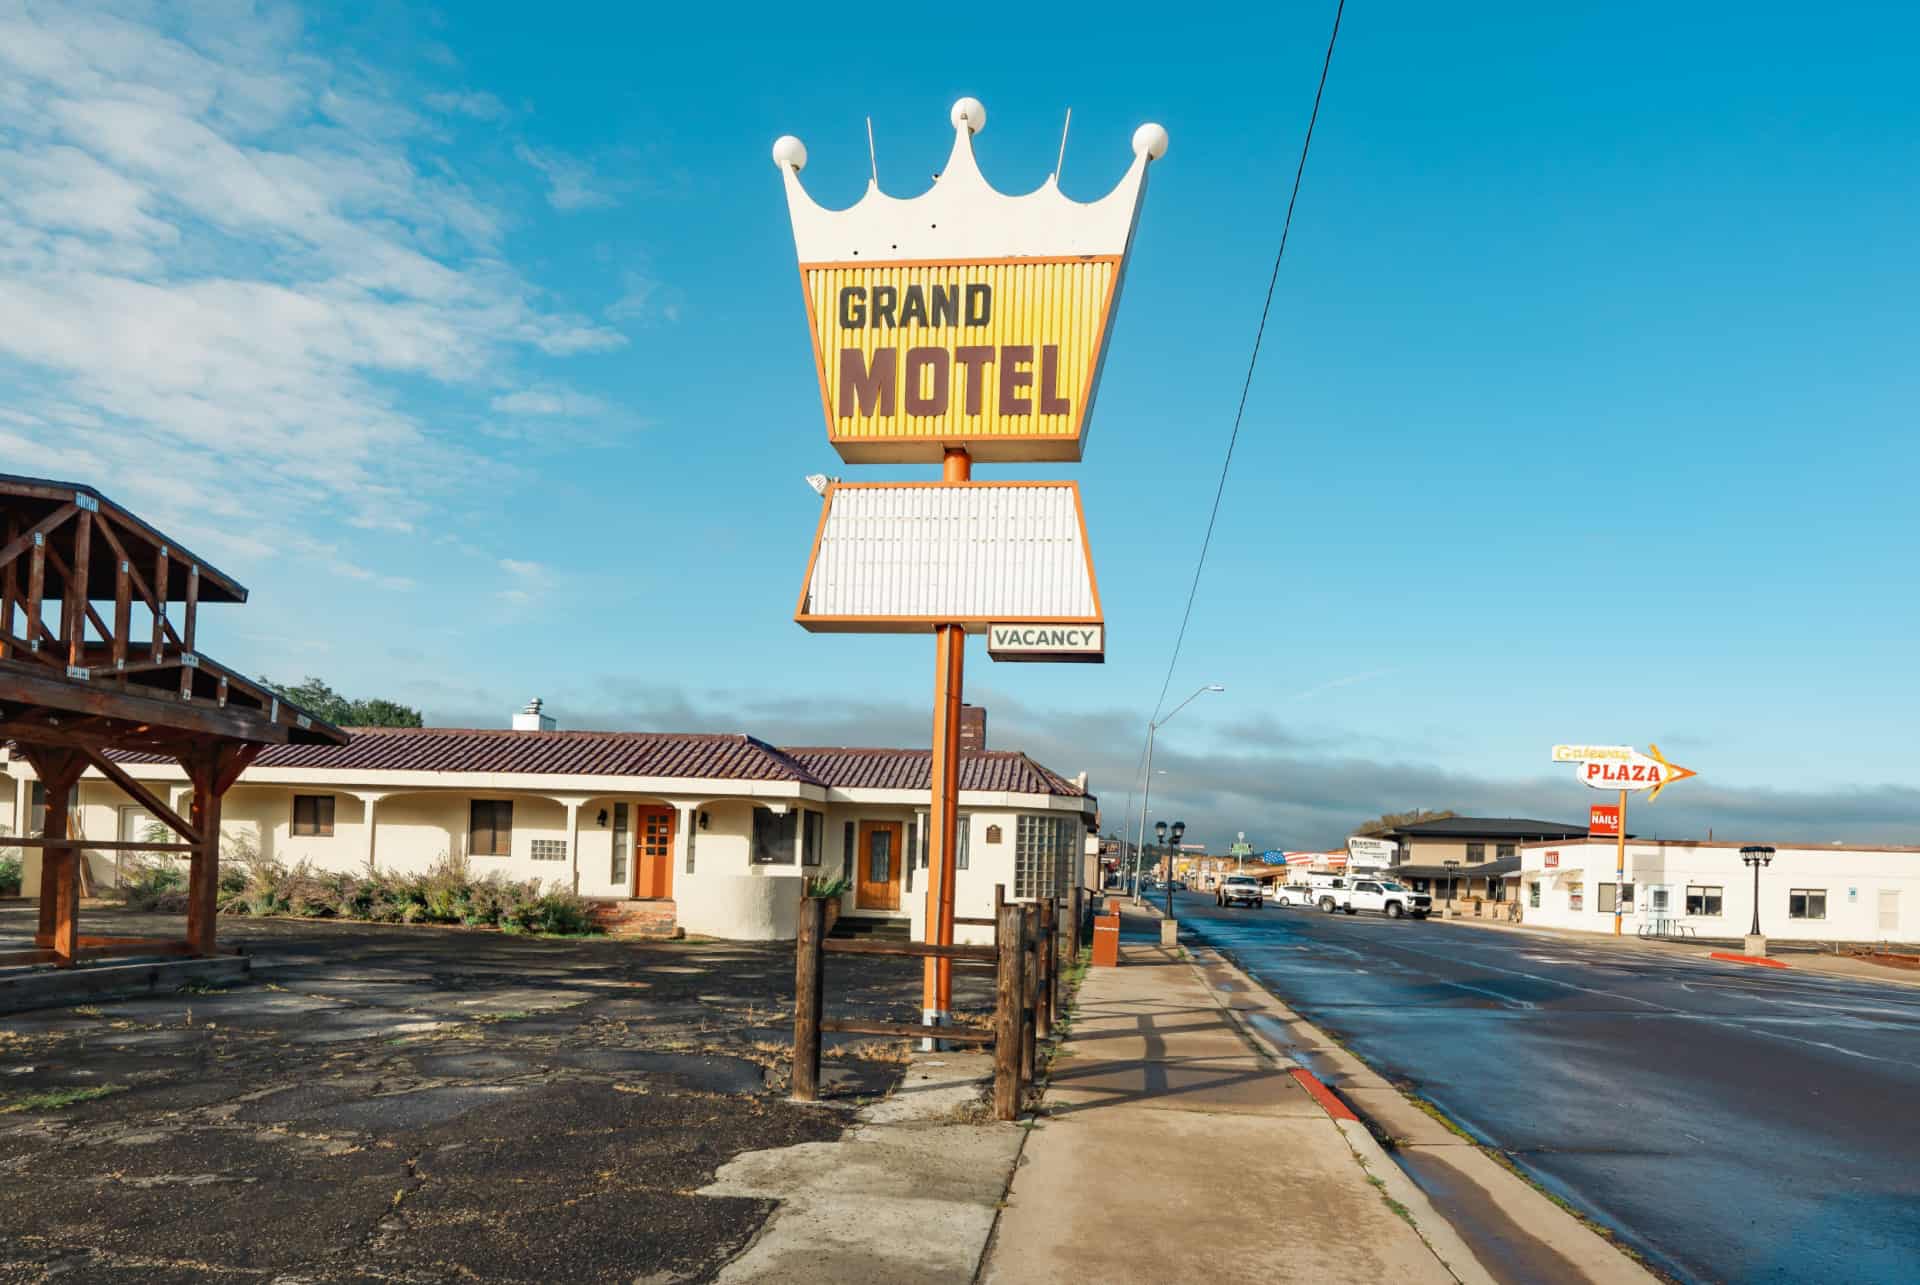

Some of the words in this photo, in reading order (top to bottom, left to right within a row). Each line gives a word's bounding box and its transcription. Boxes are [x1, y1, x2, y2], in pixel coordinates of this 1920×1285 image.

[839, 283, 992, 329] GRAND
[838, 344, 1071, 417] MOTEL
[995, 629, 1095, 646] VACANCY
[1587, 764, 1661, 782] PLAZA
[1591, 815, 1618, 825] NAILS
